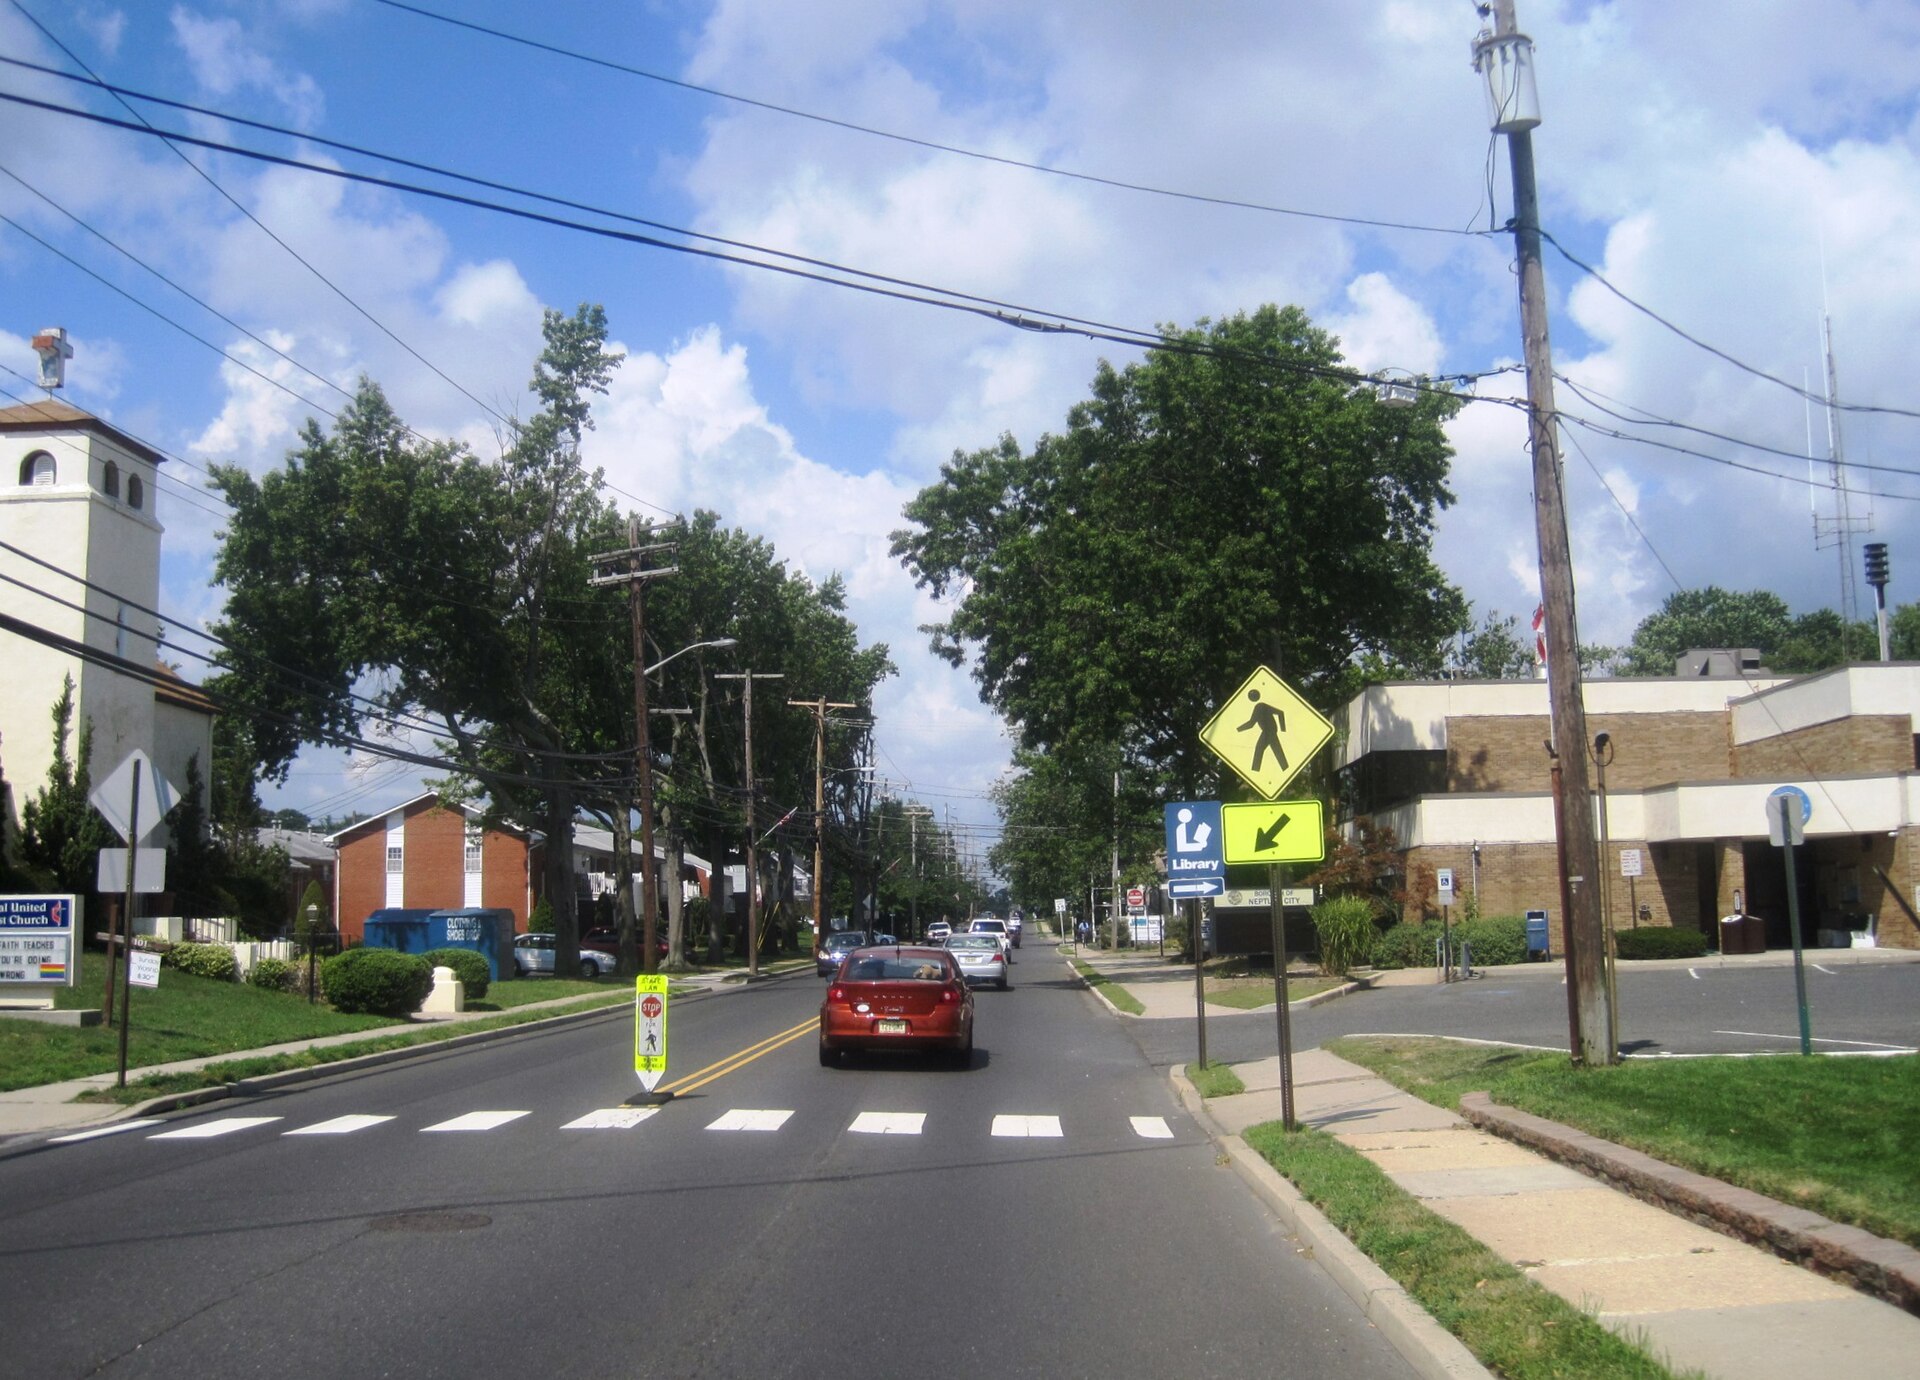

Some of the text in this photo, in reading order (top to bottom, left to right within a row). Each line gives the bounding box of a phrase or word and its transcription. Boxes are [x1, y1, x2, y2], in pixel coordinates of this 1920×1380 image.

[1172, 859, 1219, 871] Library
[1283, 897, 1300, 905] CITY
[11, 902, 47, 912] United
[9, 915, 49, 925] Church
[447, 917, 477, 929] CLOTHING
[447, 929, 465, 941] SHOES
[23, 941, 54, 950] TEACHES
[28, 956, 51, 964] DOING
[0, 971, 25, 979] WRONG
[642, 1003, 661, 1012] STOP
